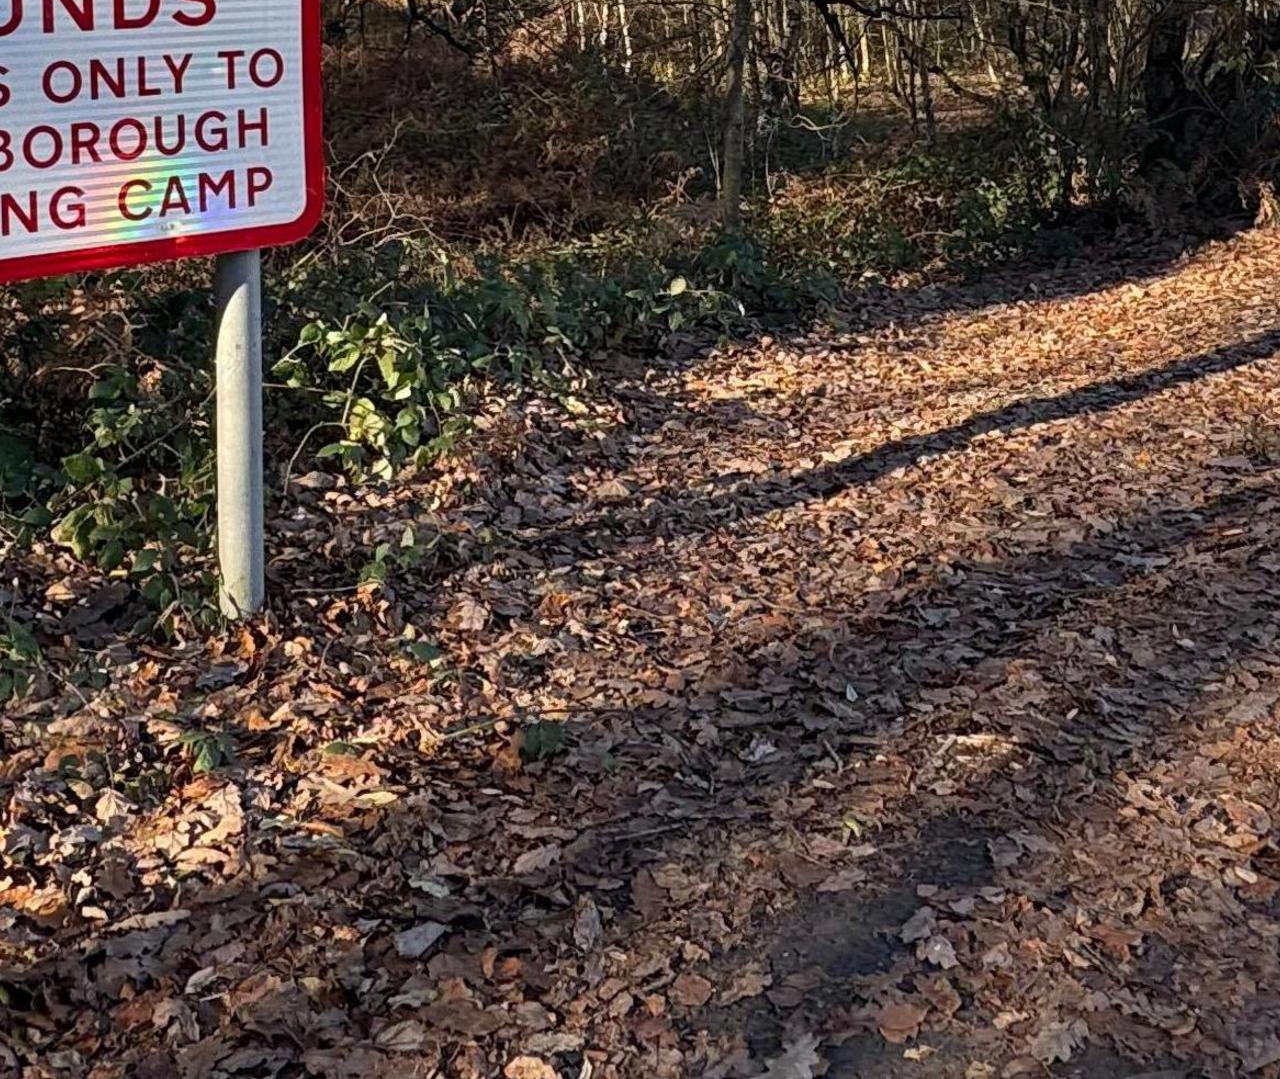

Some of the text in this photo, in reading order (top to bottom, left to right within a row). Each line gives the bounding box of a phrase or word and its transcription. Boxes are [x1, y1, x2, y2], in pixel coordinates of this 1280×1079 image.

[42, 53, 193, 103] ONLY
[218, 48, 284, 89] TO
[117, 167, 273, 220] CAMP
